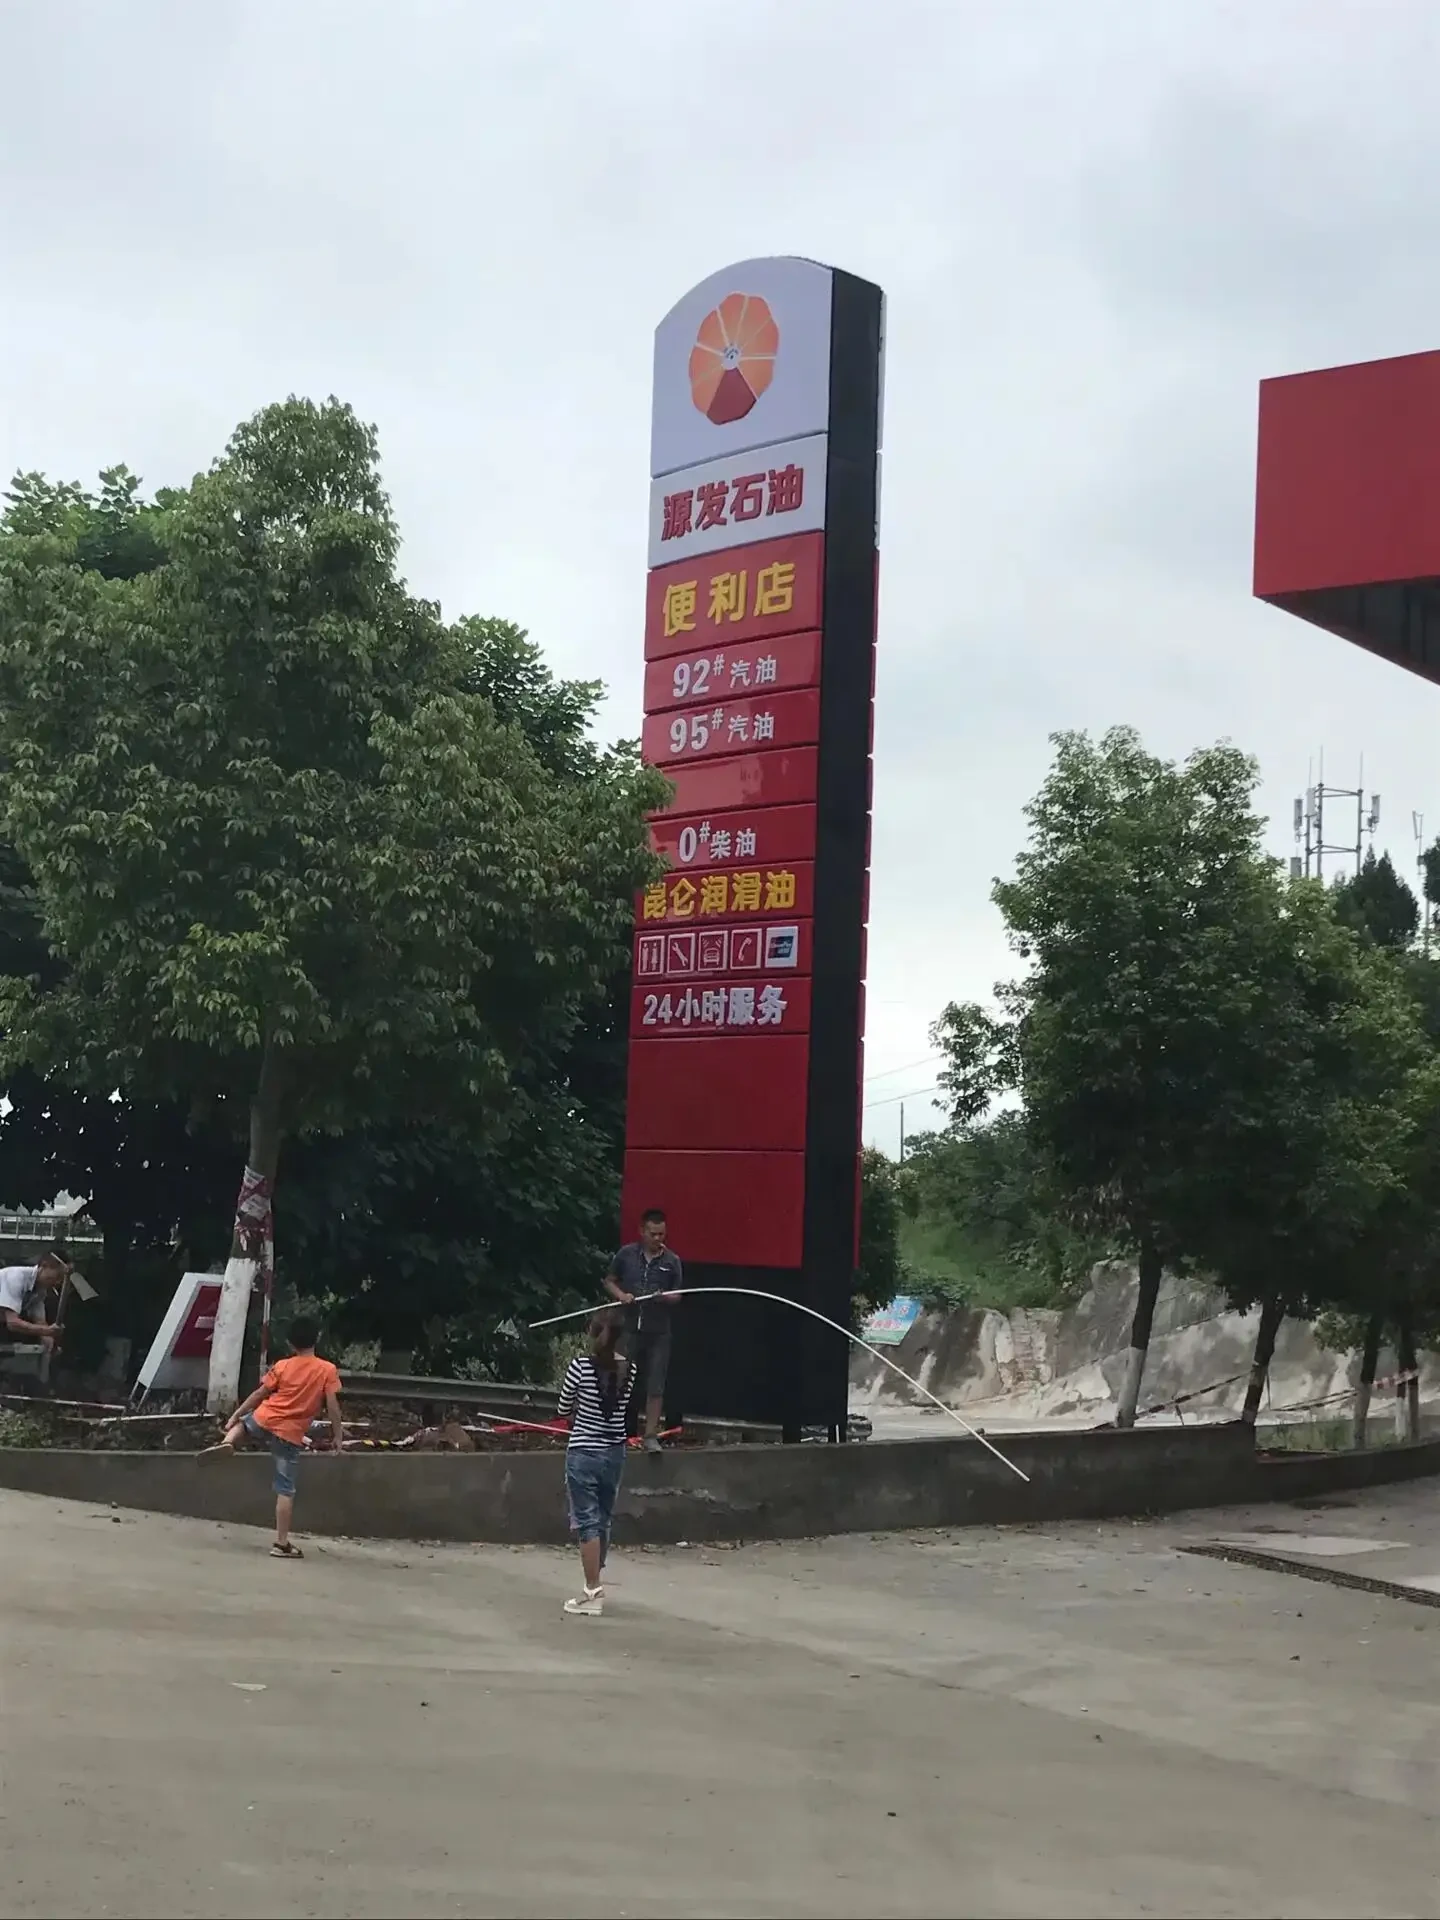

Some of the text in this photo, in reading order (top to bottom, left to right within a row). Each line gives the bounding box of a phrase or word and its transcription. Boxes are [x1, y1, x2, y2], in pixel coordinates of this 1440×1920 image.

[661, 464, 804, 541] 源发石油
[662, 562, 795, 637] 便利店
[643, 870, 796, 920] 昆仑润滑油
[642, 985, 787, 1026] 24小时服务
